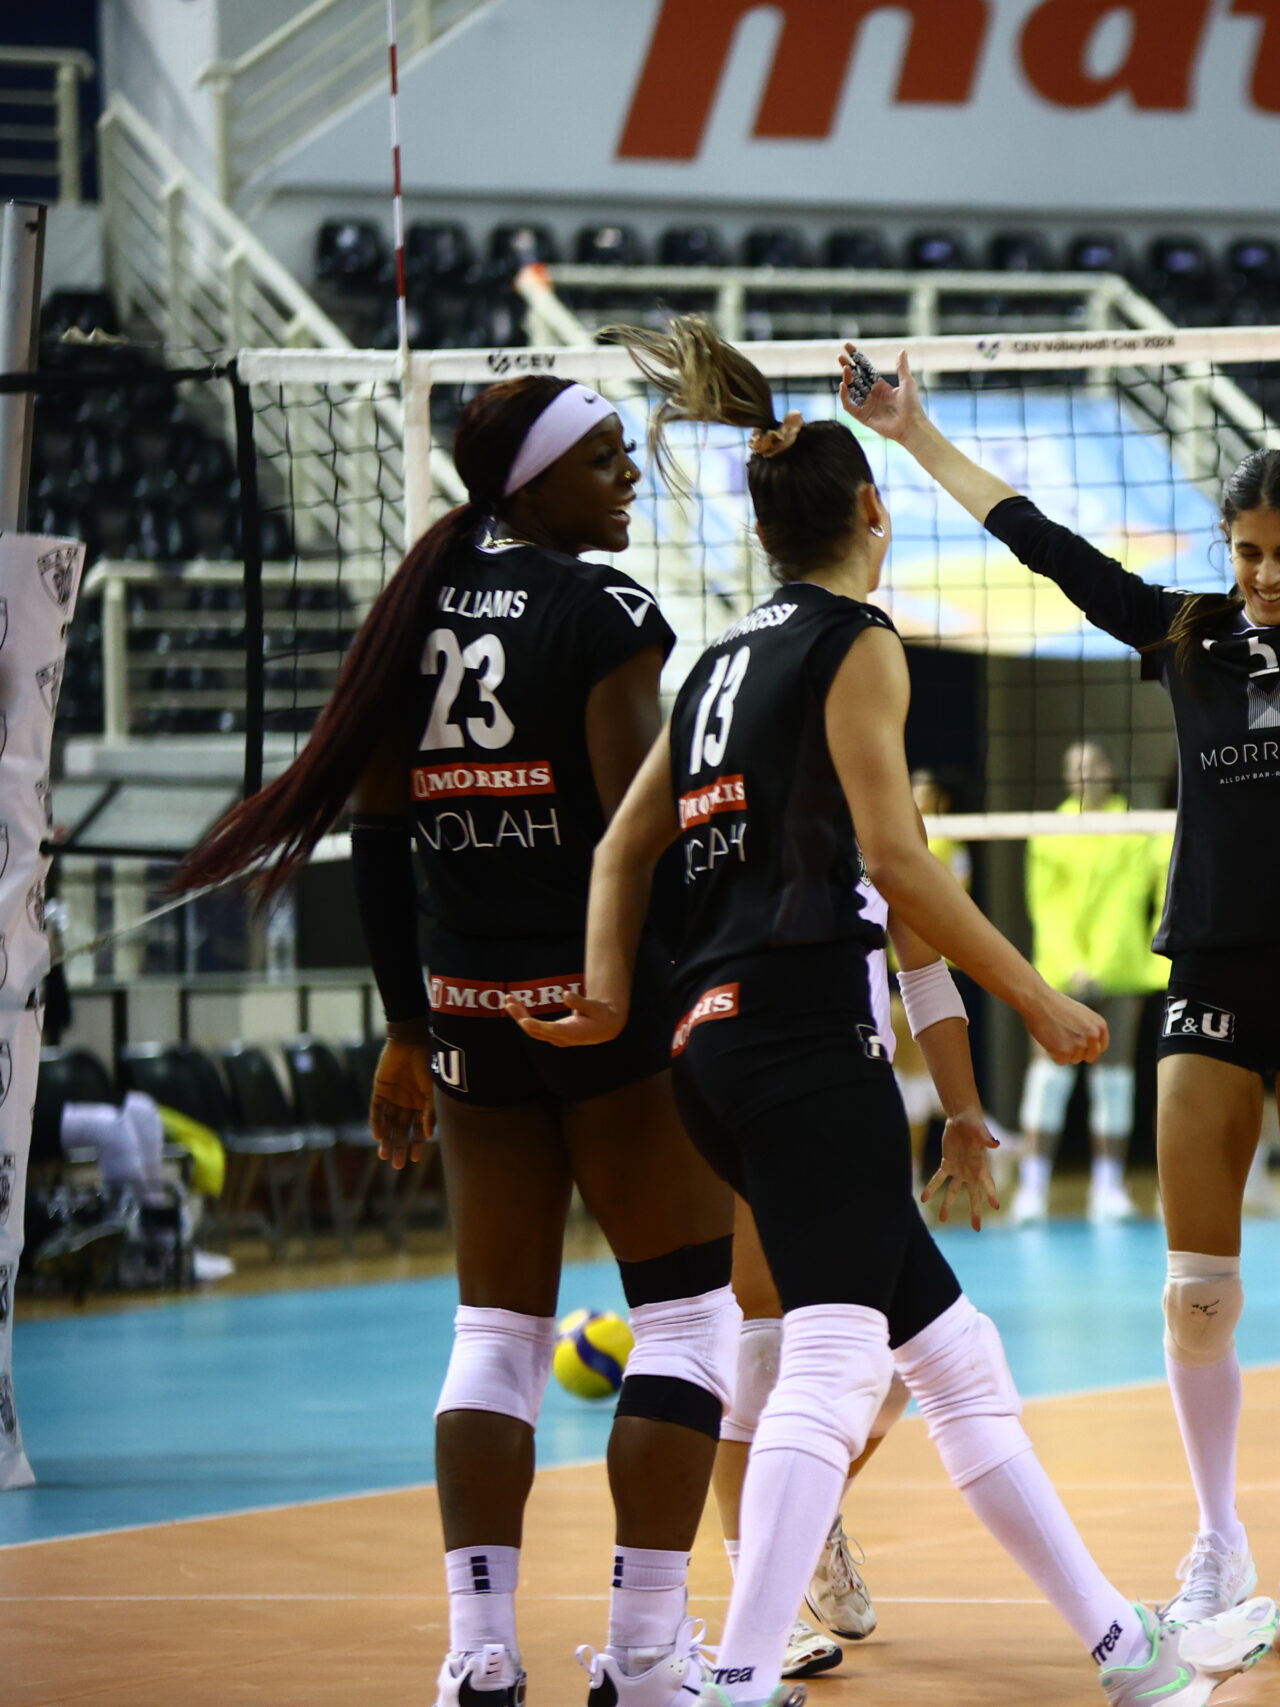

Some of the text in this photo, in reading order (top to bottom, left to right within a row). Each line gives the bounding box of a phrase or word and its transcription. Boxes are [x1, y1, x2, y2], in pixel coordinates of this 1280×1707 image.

[1045, 337, 1109, 354] Volleyball
[1113, 337, 1138, 352] Cup
[514, 353, 557, 370] CEV
[419, 628, 516, 751] 23
[690, 645, 750, 775] 13
[427, 768, 550, 792] MORRIS
[1220, 777, 1234, 785] ALL
[1236, 774, 1250, 783] DAY
[446, 983, 582, 1010] MORRI
